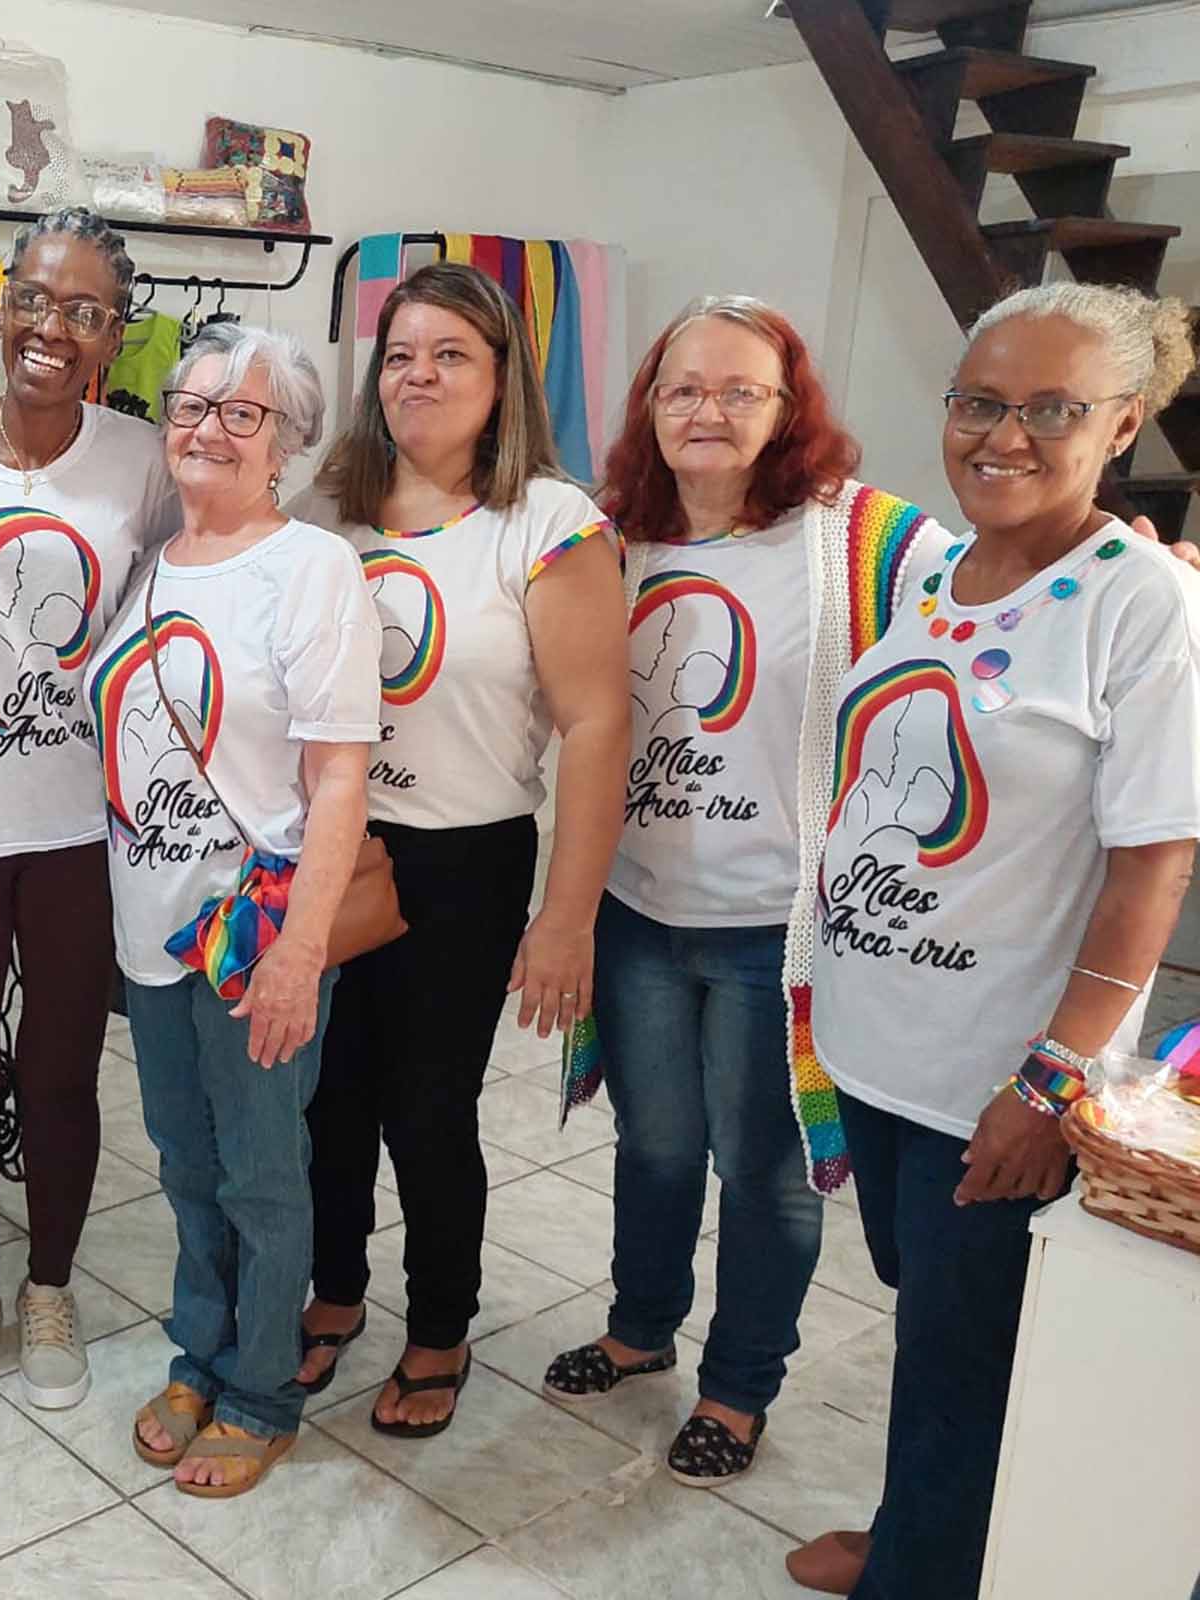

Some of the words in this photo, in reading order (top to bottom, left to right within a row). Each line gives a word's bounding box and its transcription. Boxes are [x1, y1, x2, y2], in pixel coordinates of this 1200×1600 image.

[628, 736, 726, 786] Mães
[135, 778, 221, 830] Mães
[829, 853, 940, 917] Mães
